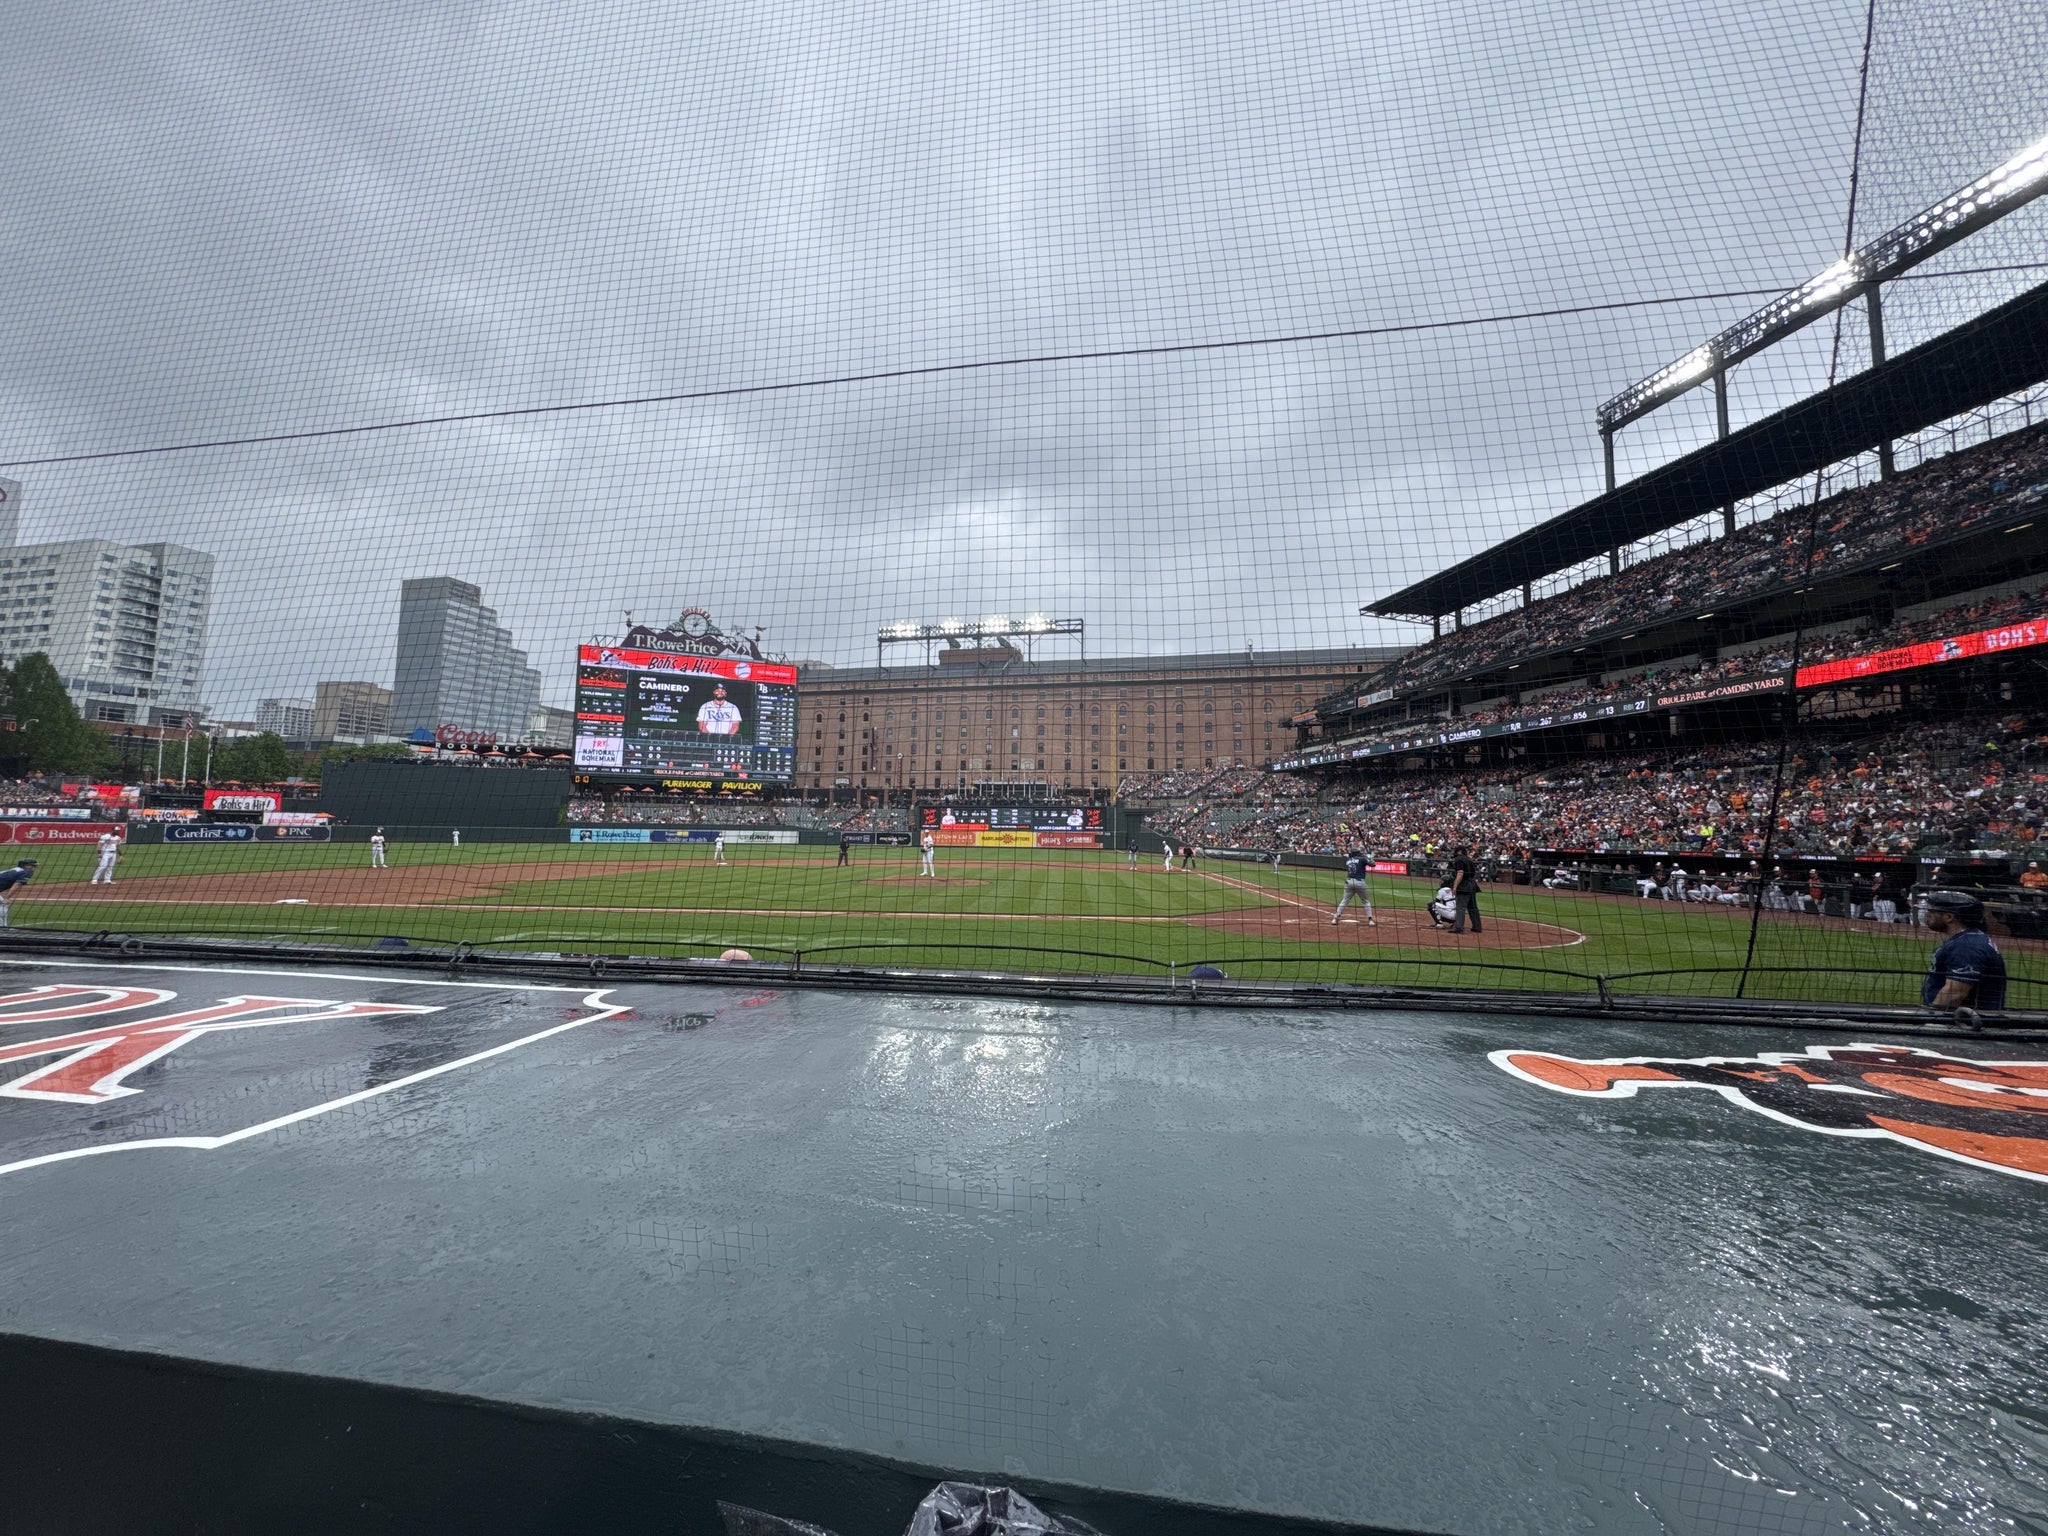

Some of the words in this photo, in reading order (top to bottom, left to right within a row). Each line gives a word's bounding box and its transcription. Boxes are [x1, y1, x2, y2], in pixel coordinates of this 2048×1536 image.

[639, 681, 690, 693] CAMINERO
[1657, 694, 1686, 706] ORIOLE
[1686, 690, 1707, 702] PARK
[1716, 683, 1754, 696] CAMDEN
[1754, 677, 1785, 690] YARDS
[1449, 729, 1482, 742] CAMINERO
[1605, 706, 1615, 715] 13
[1635, 700, 1646, 710] 27
[436, 723, 497, 744] Coors
[435, 742, 478, 751] ROOF
[492, 744, 533, 753] DECK
[582, 748, 616, 757] NATIONAL
[581, 755, 616, 763] BOHEMIAN
[662, 779, 713, 790] PUREWAGER
[722, 781, 763, 791] PAVILION
[220, 799, 241, 810] Boh's
[47, 829, 101, 839] Budweis
[174, 827, 224, 839] CareFirst
[288, 827, 311, 836] PNC
